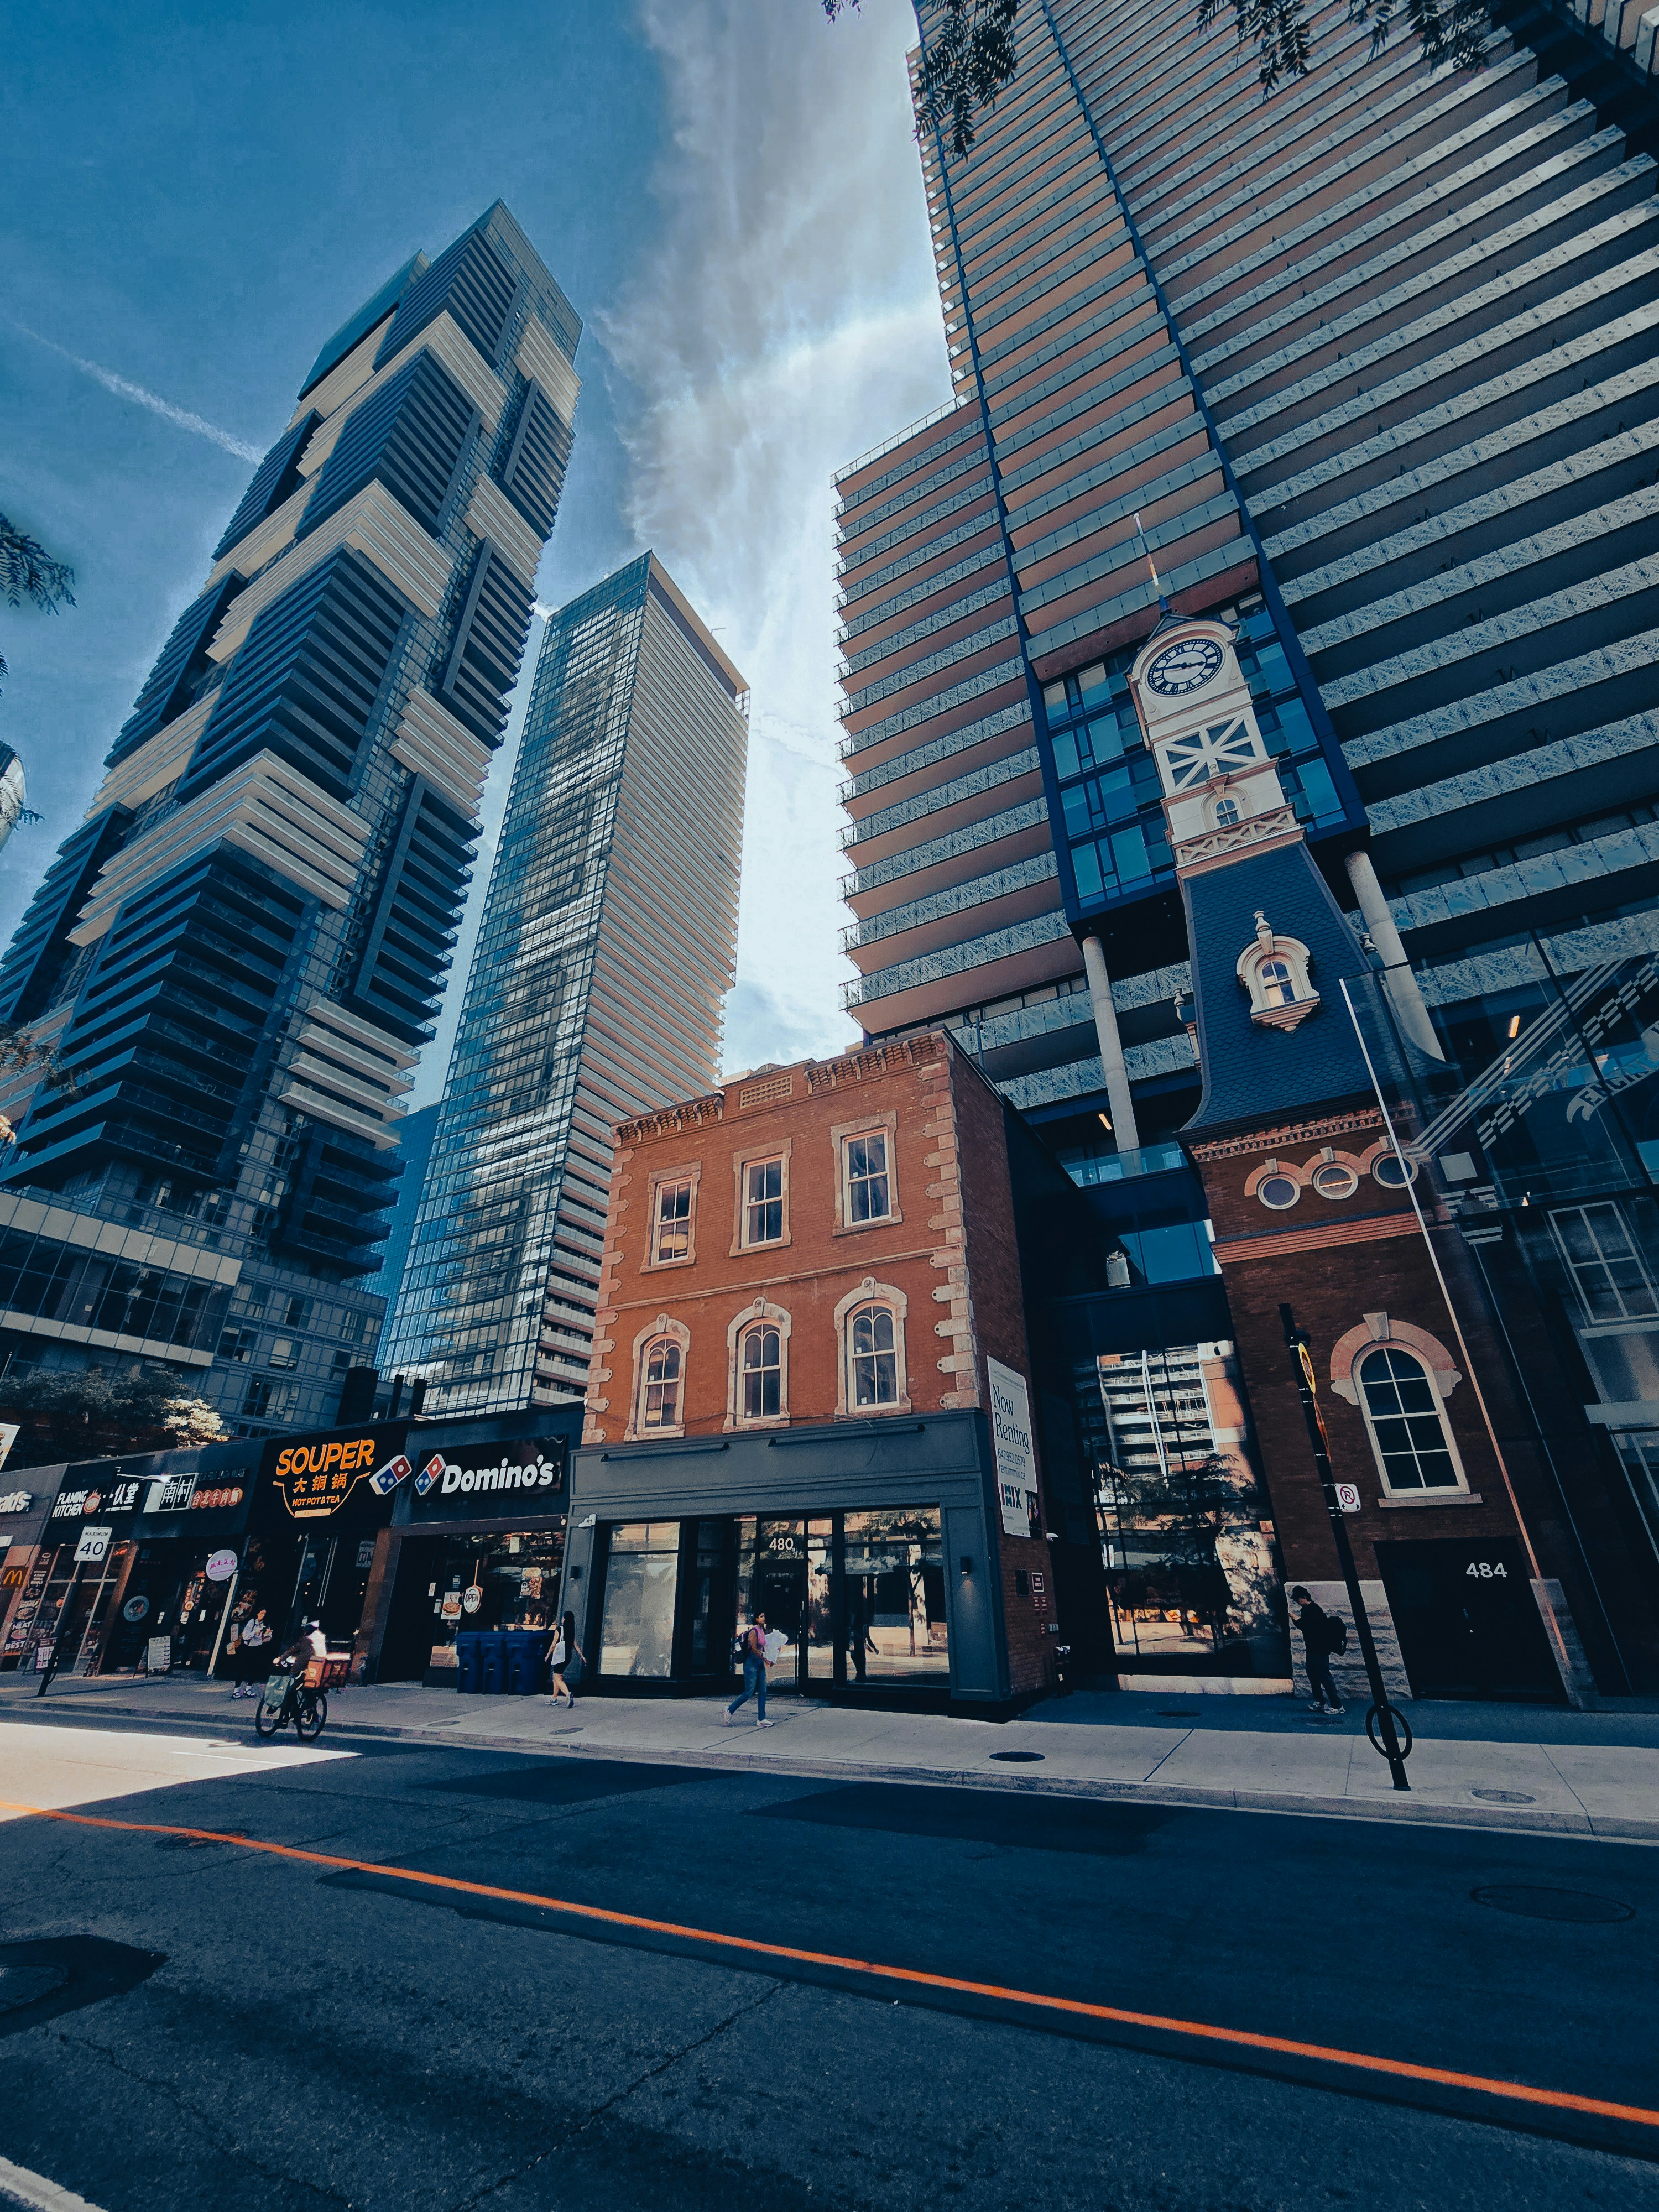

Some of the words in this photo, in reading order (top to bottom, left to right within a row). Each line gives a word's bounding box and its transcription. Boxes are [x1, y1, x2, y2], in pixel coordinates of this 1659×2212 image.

[992, 1383, 1013, 1416] Now
[994, 1411, 1030, 1454] Renting
[276, 1439, 375, 1475] SOUPER
[441, 1454, 554, 1493] Domino's
[293, 1473, 348, 1493] 大铜锅
[56, 1490, 88, 1505] FLAMING
[292, 1498, 306, 1506] HOT
[306, 1496, 321, 1505] POT
[326, 1495, 340, 1504] TEA
[52, 1503, 84, 1517] KITCHEN
[80, 1541, 104, 1556] 40
[769, 1537, 794, 1550] 480
[1465, 1562, 1507, 1579] 484
[465, 1593, 478, 1603] OPEN
[5, 1641, 26, 1650] BEST
